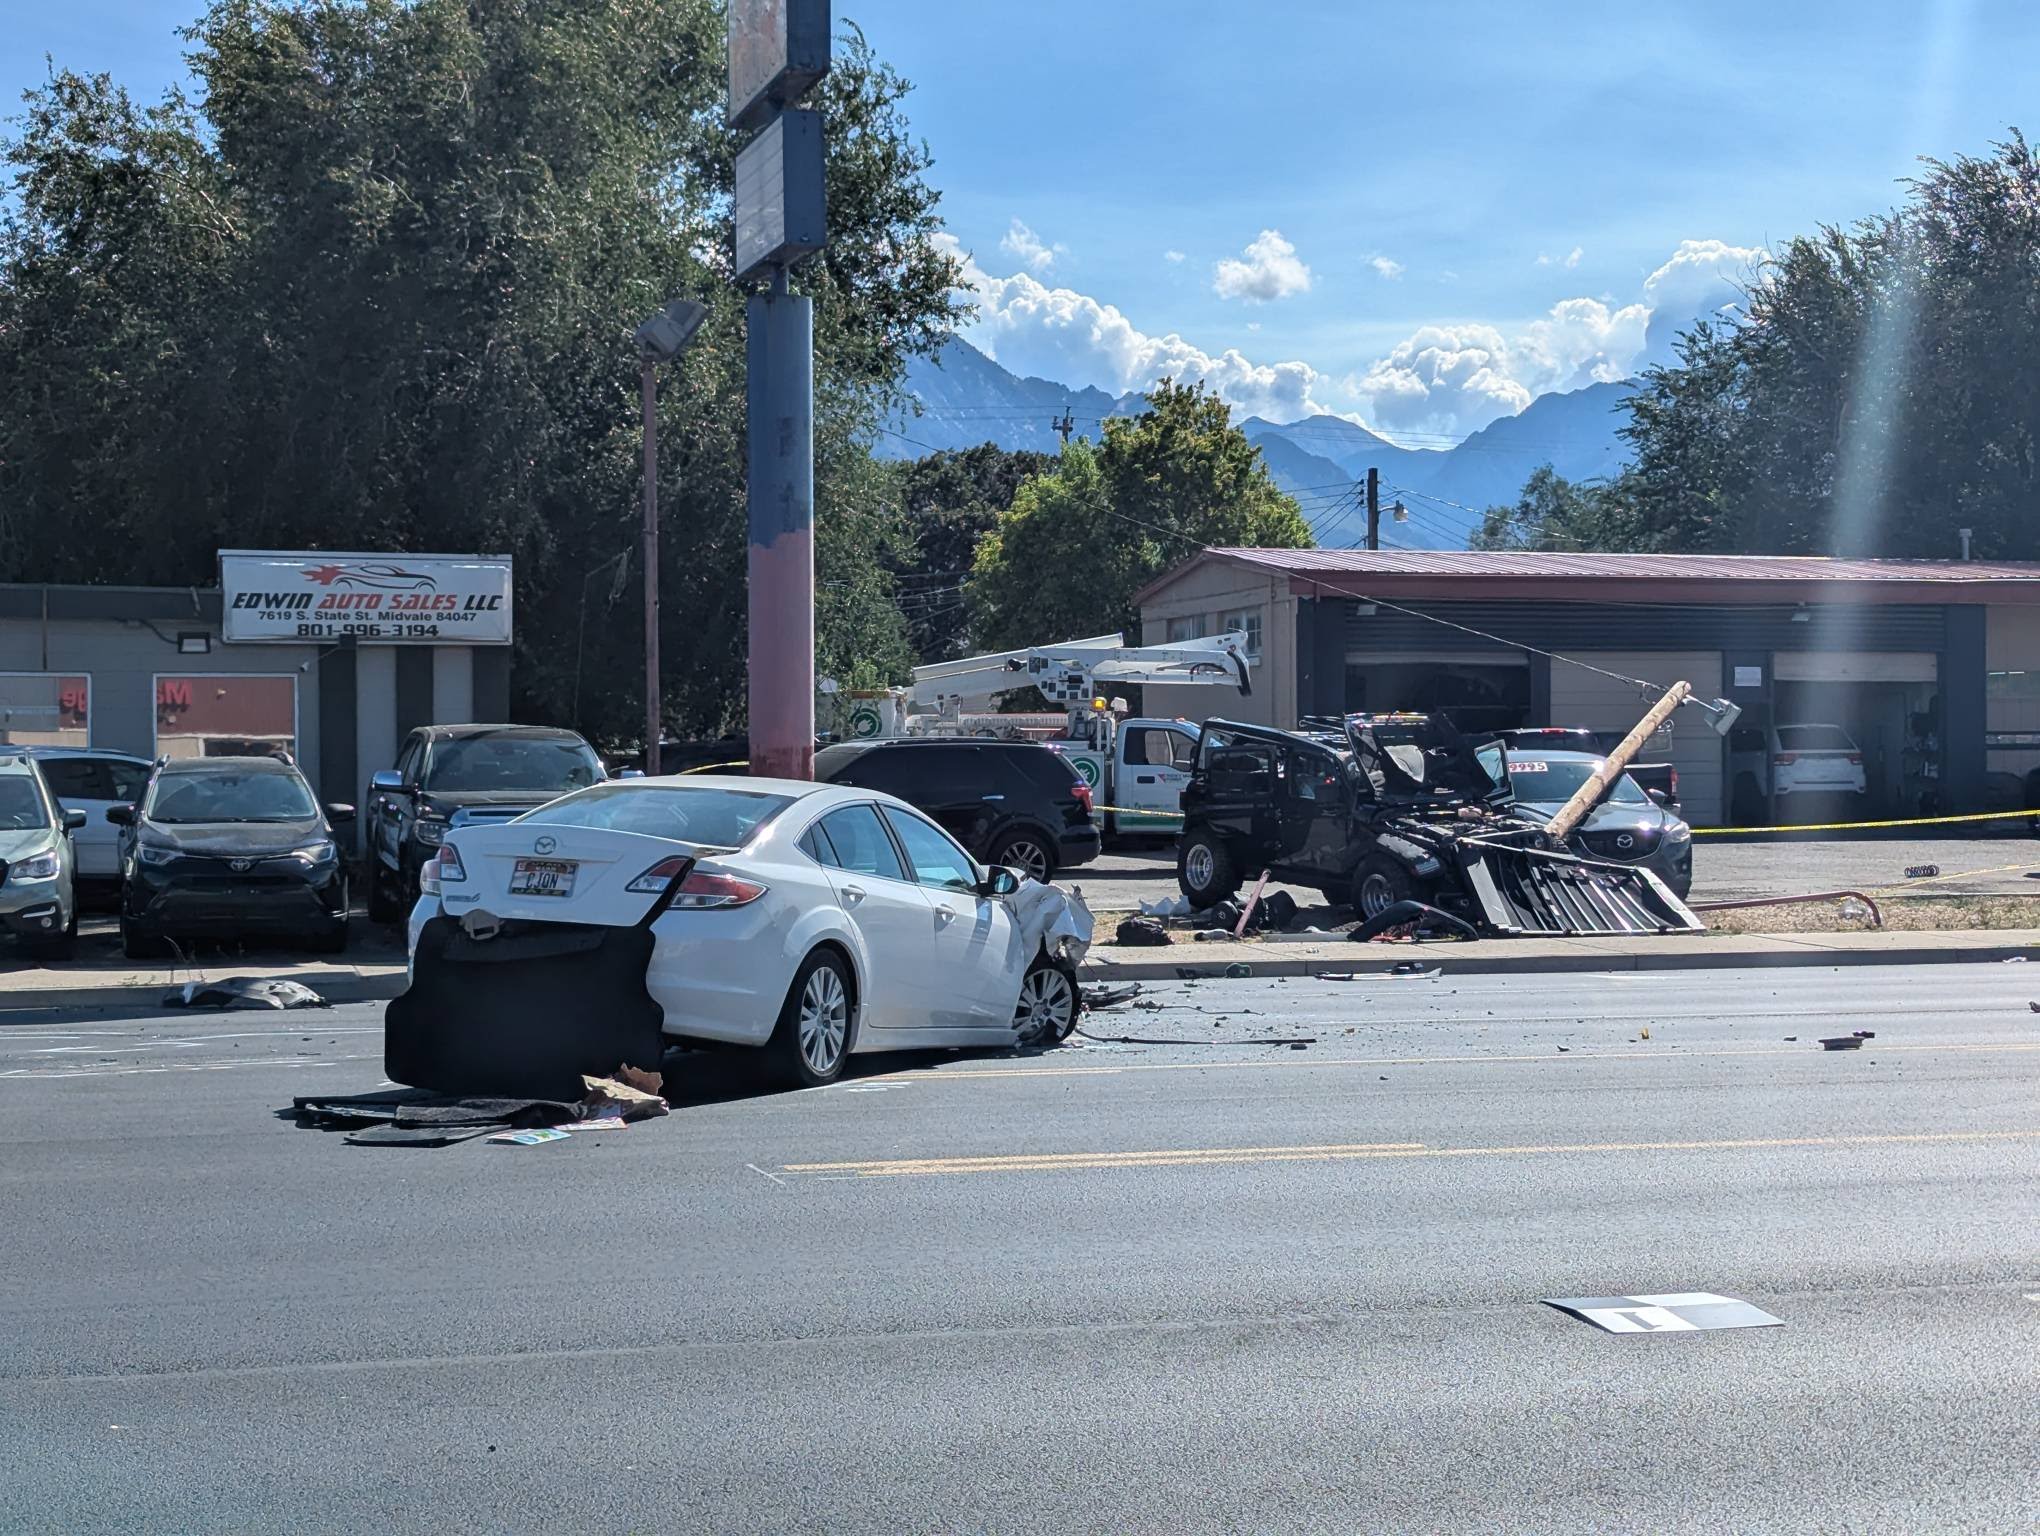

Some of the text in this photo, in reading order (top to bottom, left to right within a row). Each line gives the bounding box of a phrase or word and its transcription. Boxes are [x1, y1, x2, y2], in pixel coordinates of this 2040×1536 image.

[232, 592, 314, 609] EDWIN
[463, 594, 503, 610] LLC
[258, 611, 477, 622] 7619 S. State St. Midvale 84047
[297, 623, 439, 637] 801-996-3194
